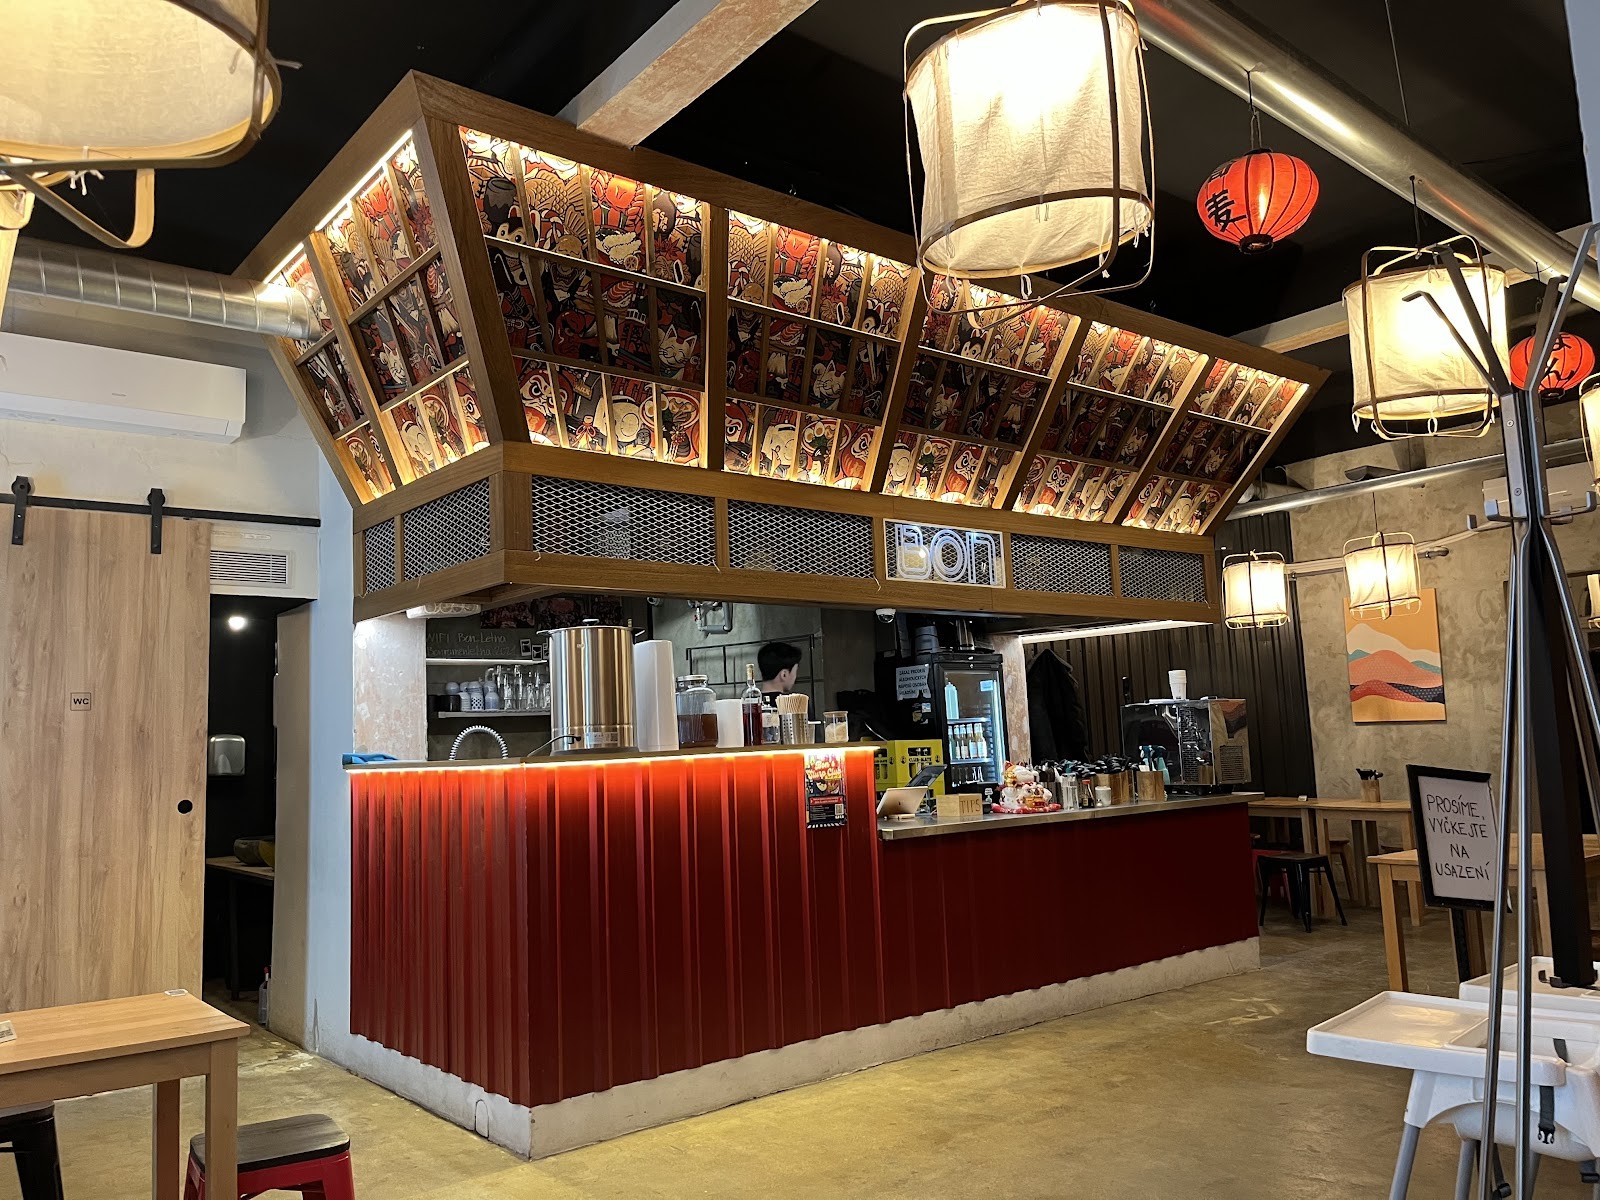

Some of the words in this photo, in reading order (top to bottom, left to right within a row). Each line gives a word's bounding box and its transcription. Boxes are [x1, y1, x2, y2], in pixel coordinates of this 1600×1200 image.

[73, 697, 89, 705] WC
[960, 799, 981, 814] TIPS
[1428, 816, 1488, 838] VYČKEJTE
[1449, 843, 1470, 859] NA
[1435, 861, 1490, 881] USAZENÍ
